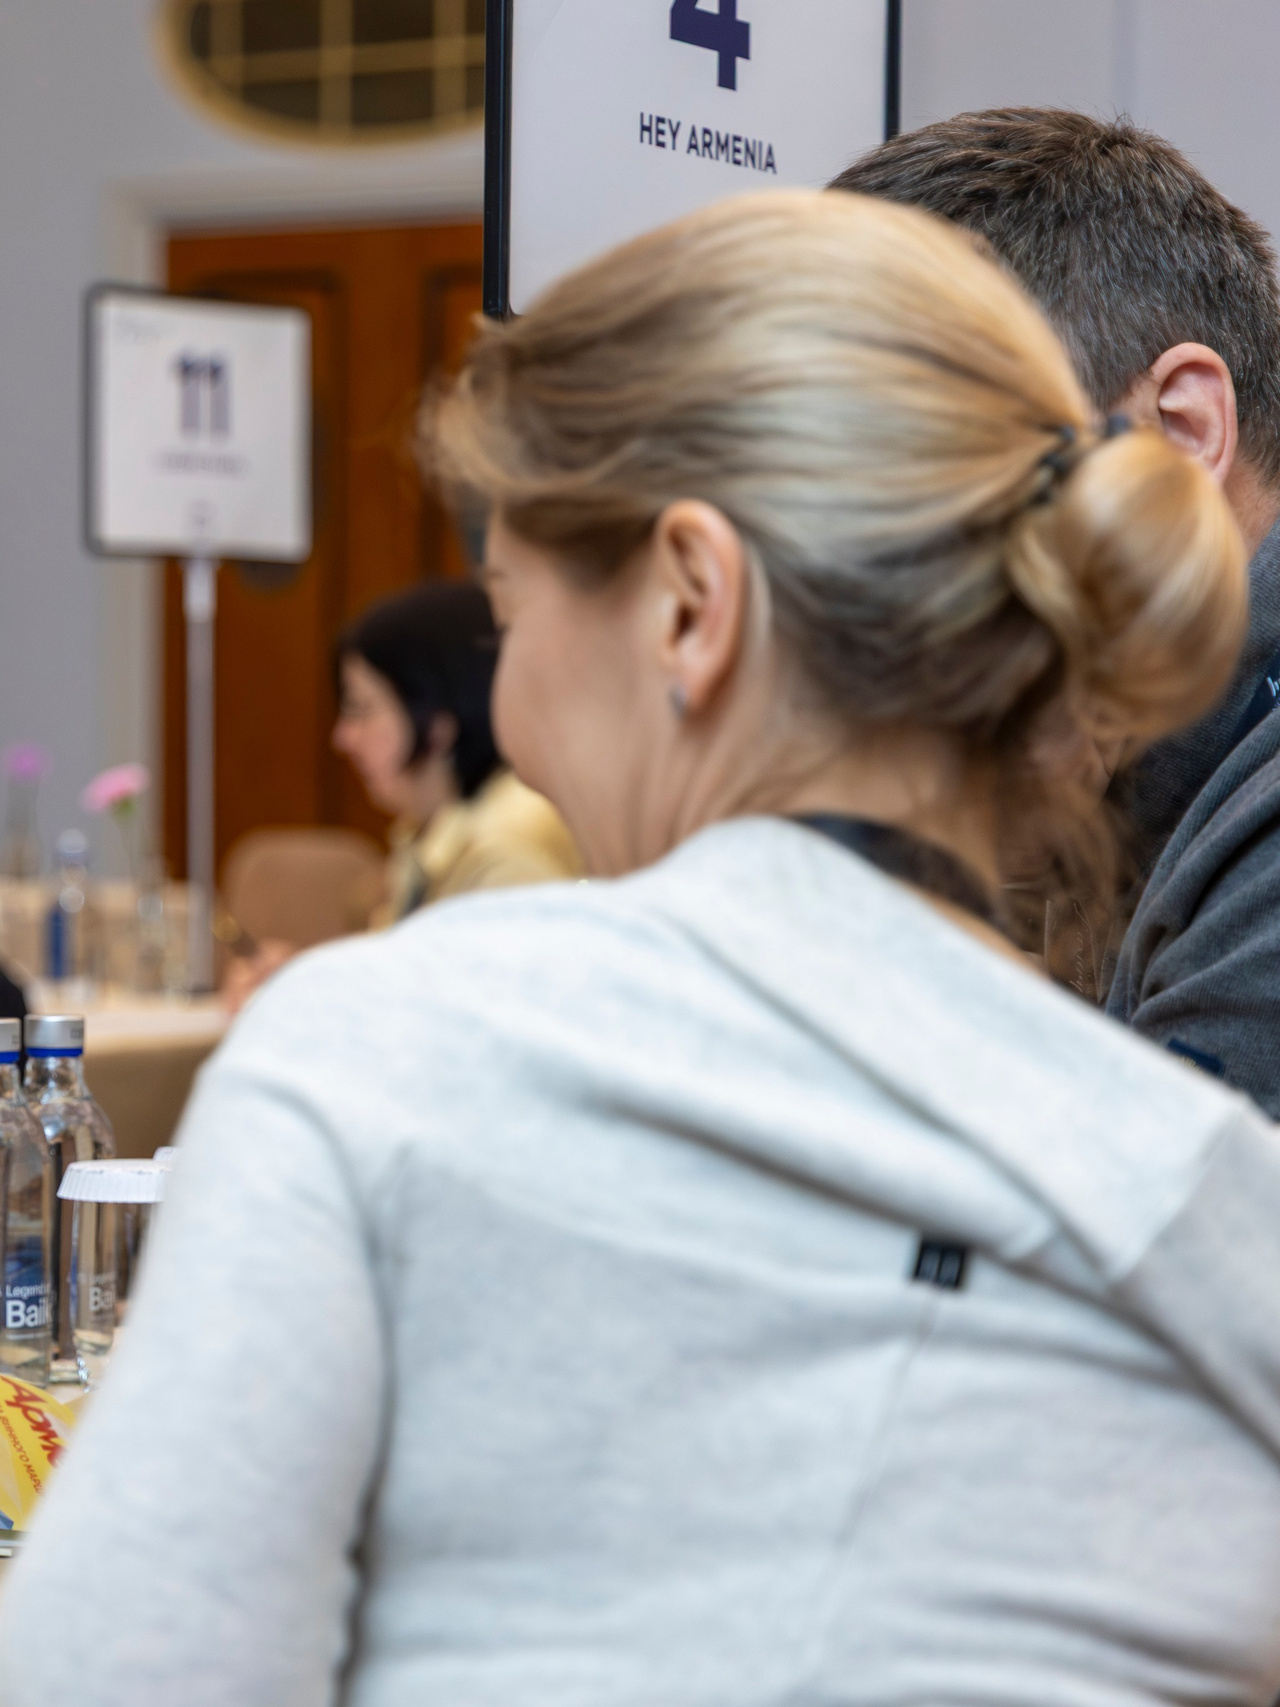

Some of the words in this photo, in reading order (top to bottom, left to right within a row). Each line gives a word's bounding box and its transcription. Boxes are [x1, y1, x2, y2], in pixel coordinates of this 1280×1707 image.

[669, 0, 751, 91] 4
[639, 111, 682, 151] HEY
[686, 123, 778, 175] ARMENIA
